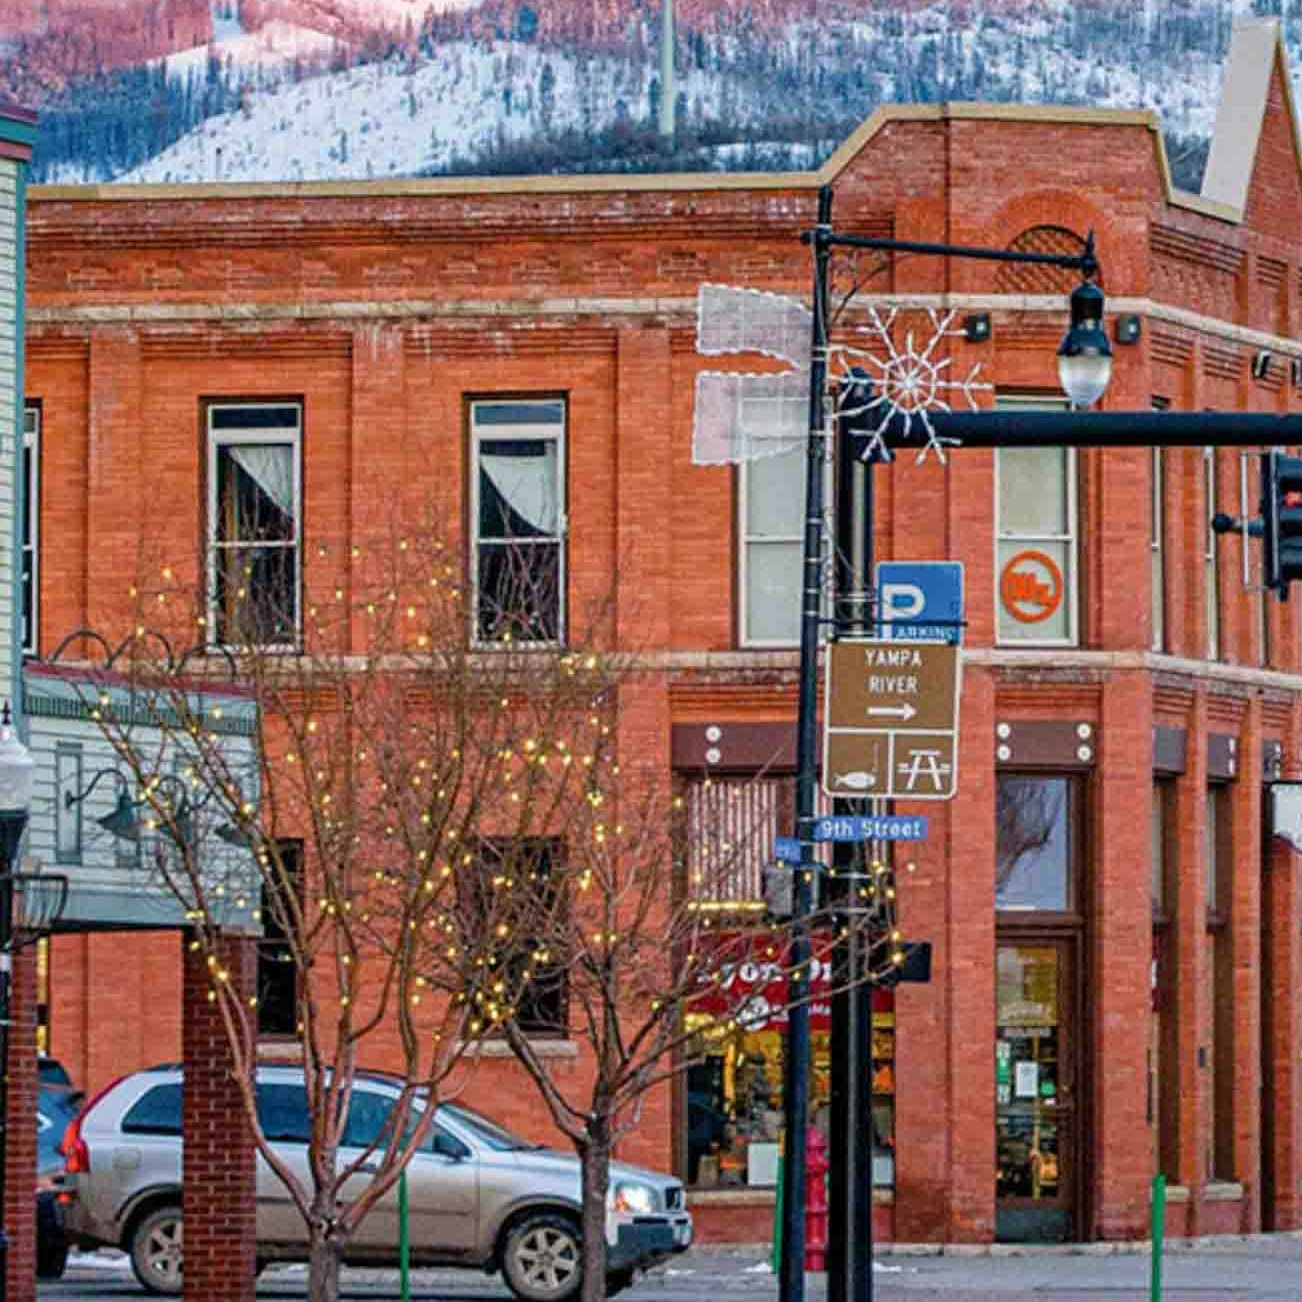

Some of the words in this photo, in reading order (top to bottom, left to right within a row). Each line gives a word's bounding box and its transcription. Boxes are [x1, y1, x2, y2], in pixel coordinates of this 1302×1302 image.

[881, 584, 925, 639] P
[864, 649, 922, 667] YAMPA
[868, 675, 918, 694] RIVER
[821, 820, 853, 838] 9th
[861, 820, 921, 838] Street
